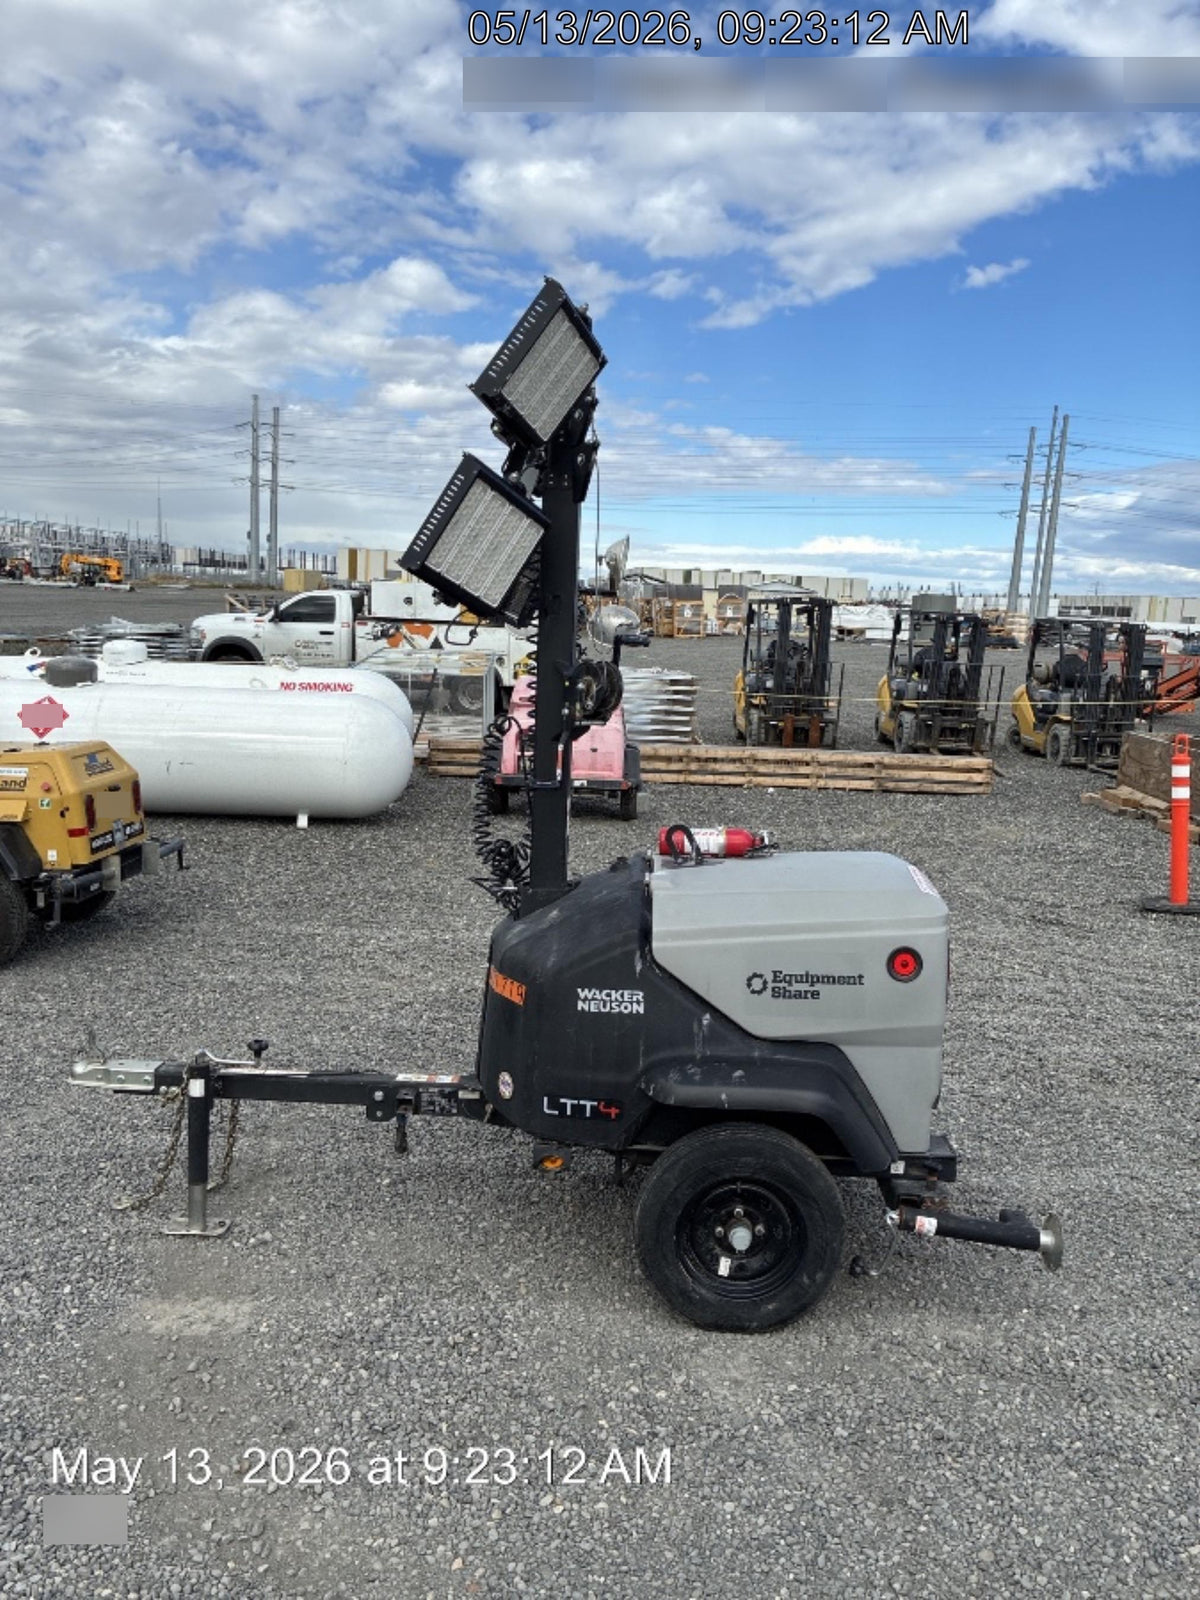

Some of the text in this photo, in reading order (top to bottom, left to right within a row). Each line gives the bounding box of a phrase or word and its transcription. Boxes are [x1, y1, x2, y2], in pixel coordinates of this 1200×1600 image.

[280, 681, 354, 693] NO SMOKING
[771, 970, 865, 987] Equipment
[576, 988, 645, 1002] WACKER
[771, 986, 820, 1000] Share
[577, 1001, 645, 1014] NEUSON
[543, 1096, 620, 1120] LTT4
